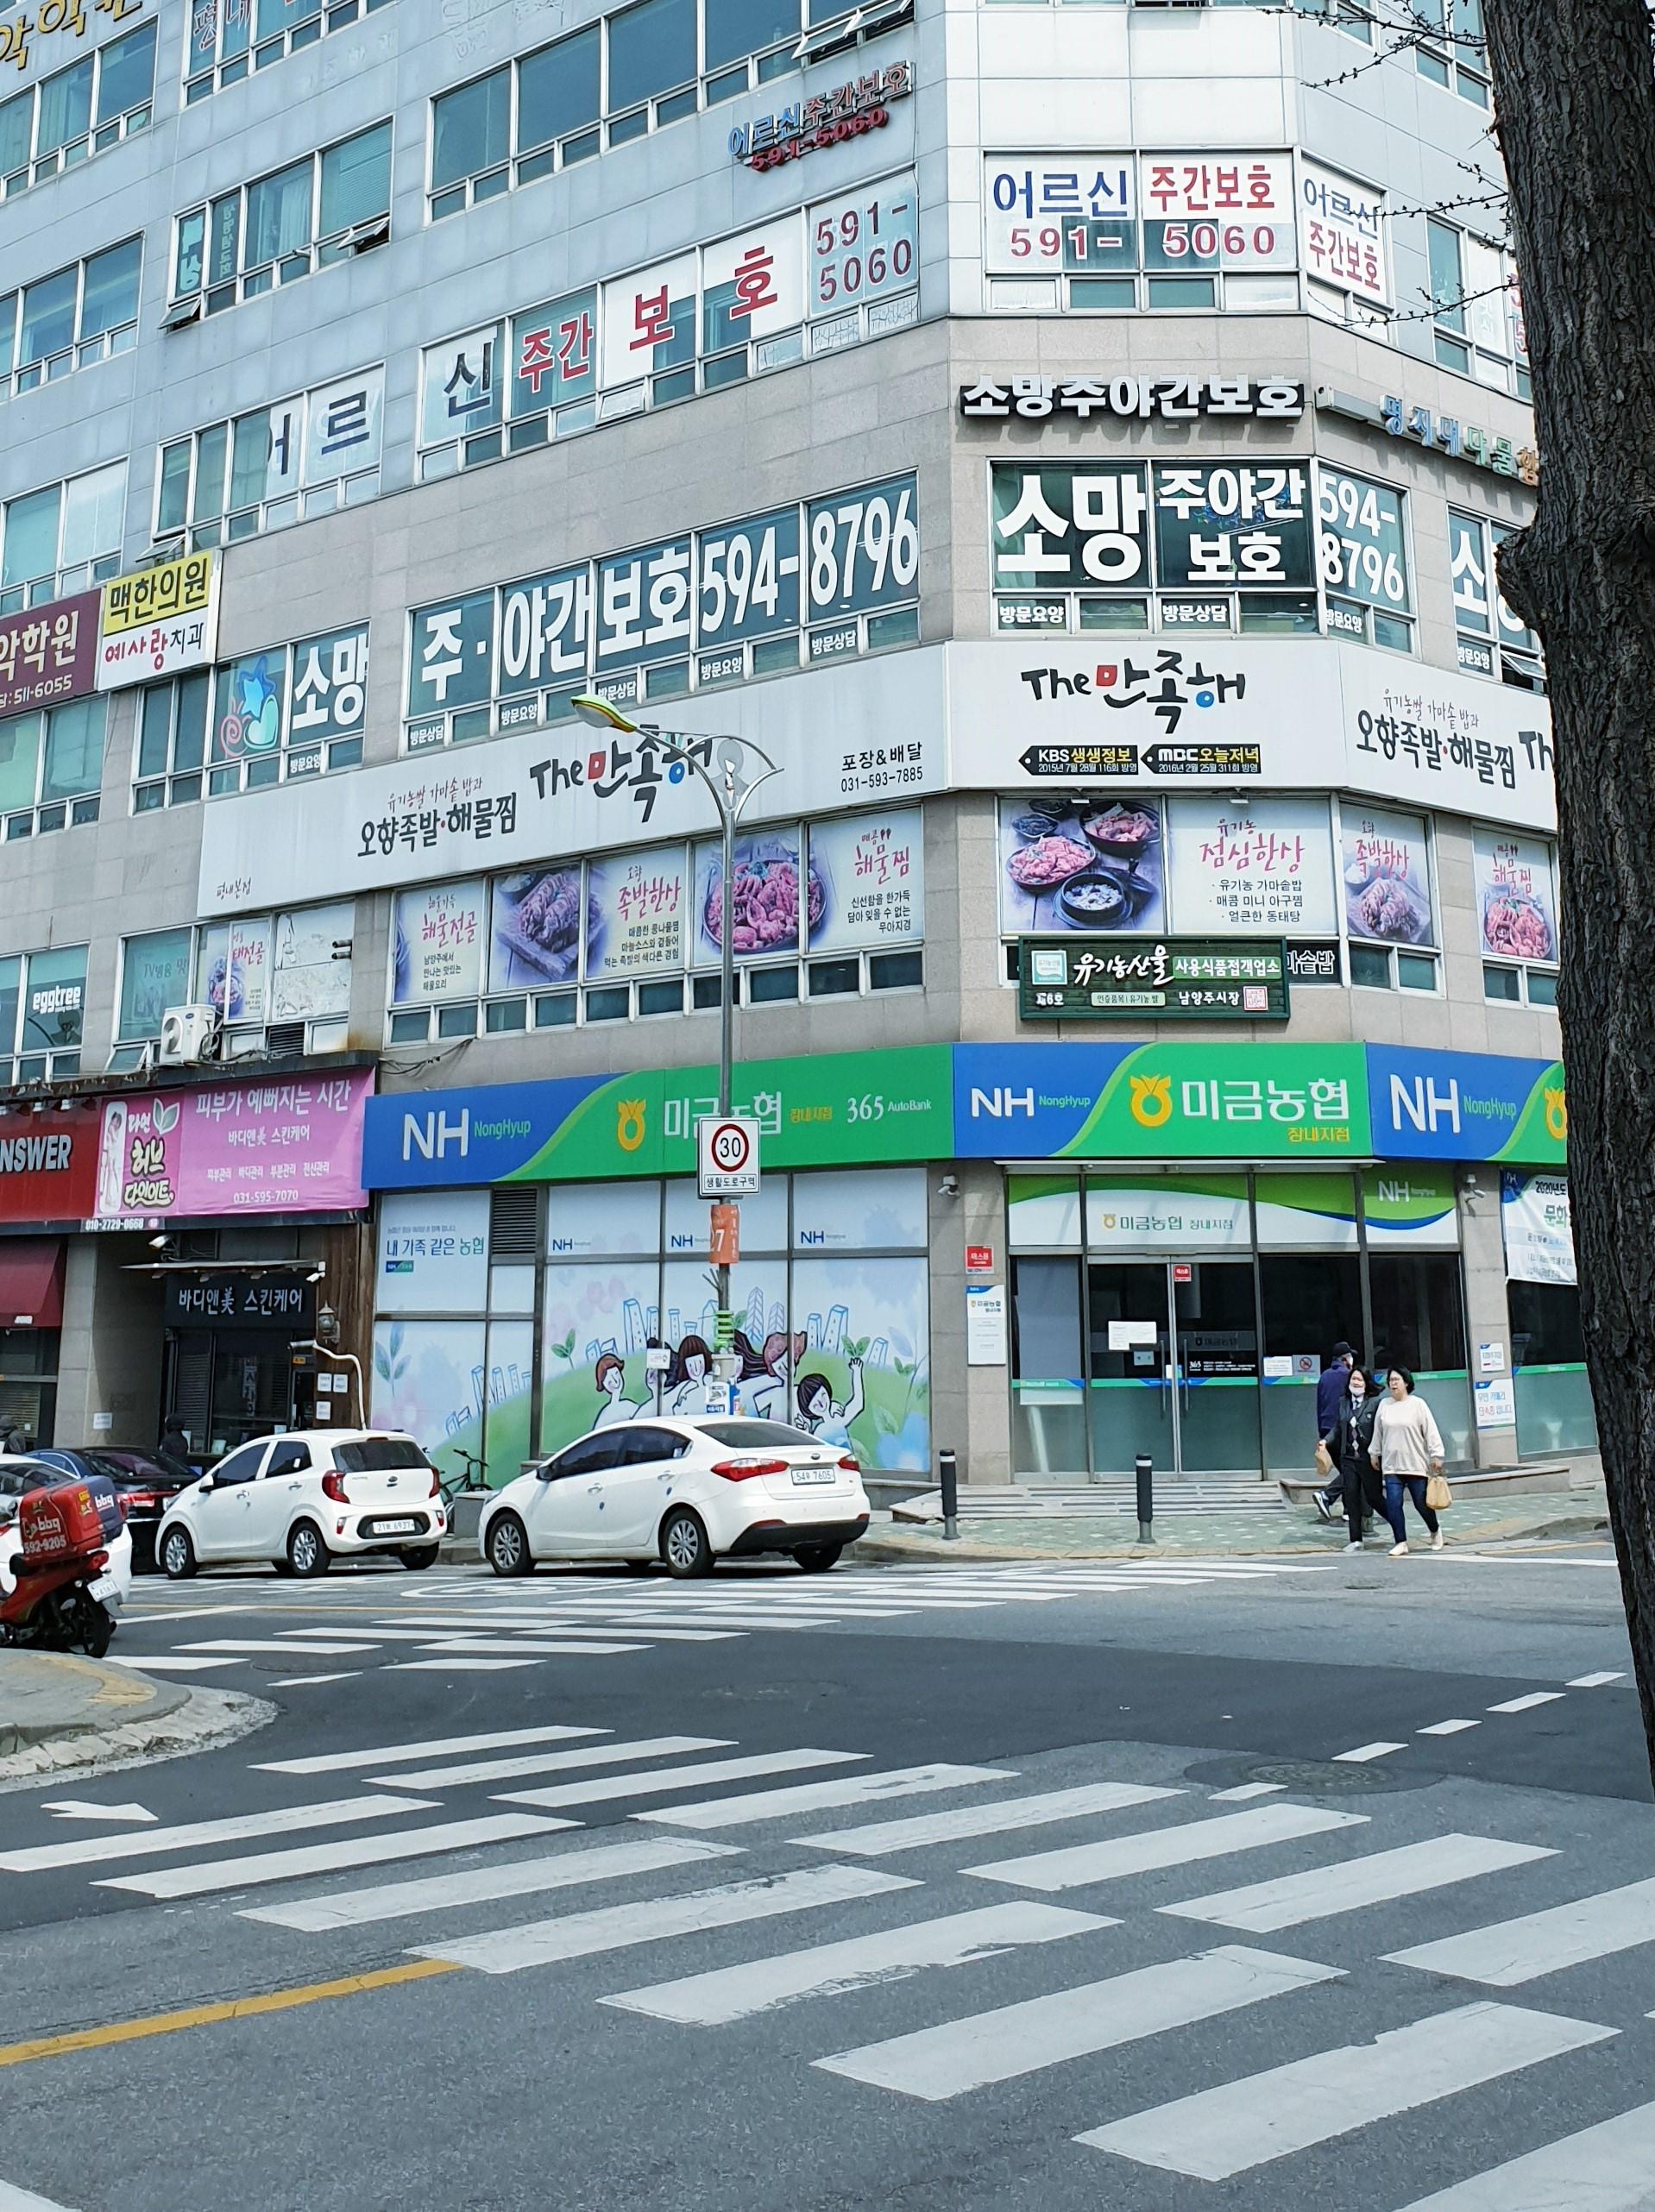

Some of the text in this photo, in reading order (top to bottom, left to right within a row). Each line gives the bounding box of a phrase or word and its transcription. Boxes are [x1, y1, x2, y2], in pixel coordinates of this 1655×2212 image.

[752, 106, 890, 173] 591-5060
[993, 164, 1274, 219] 어르신 주간보호
[1304, 178, 1379, 242] 어르신
[816, 201, 909, 256] 591-
[1010, 223, 1276, 259] 591- 5060
[1309, 220, 1381, 292] 주간보호
[820, 238, 912, 304] 5060
[962, 374, 1304, 419] 소망주야간보호
[1318, 471, 1396, 537] 594-
[997, 468, 1306, 581] 소망 주야간
[1187, 531, 1287, 581] 보호
[1320, 531, 1405, 602] 8796
[109, 557, 209, 623] 맥한의원
[998, 605, 1066, 624] 방문요양
[1161, 603, 1228, 624] 방문상담
[1325, 607, 1363, 635] 방문요양
[104, 622, 205, 670] 예사랑치과
[811, 630, 857, 656] 방문상담
[293, 632, 369, 731] 소망
[700, 654, 744, 682] 방문요양
[1021, 649, 1247, 735] The만족해
[500, 702, 539, 726] 방문요양
[409, 724, 446, 747] 방문상담
[289, 753, 322, 775] 방문요양
[840, 741, 924, 772] 포장&배달
[1038, 747, 1133, 764] KBS 생생정보
[1038, 763, 1064, 773] 2015년
[1065, 763, 1079, 773] 7월
[1098, 763, 1120, 773] 116회
[1121, 763, 1138, 773] 방영
[1158, 746, 1260, 764] MBC 오늘저녁
[1158, 763, 1185, 773] 2016년
[1218, 763, 1241, 773] 311회
[840, 767, 924, 794] 031-593-7885
[1217, 818, 1257, 838] 유기농
[853, 844, 909, 885] 해물찜
[1199, 832, 1306, 873] 점심한상
[1218, 879, 1254, 892] 유기농
[1492, 852, 1532, 898] 해물찜
[617, 875, 682, 921] 족발한상
[851, 889, 910, 909] 신선함을 한가득
[1216, 894, 1303, 908] 매콤 미니 아구찜
[884, 907, 892, 920] 수
[894, 905, 911, 919] 없는
[1229, 910, 1301, 923] 얼큰한 동태탕
[421, 909, 479, 949] 해물전골
[1174, 957, 1281, 977] 사용식품접객업소
[32, 984, 82, 1015] eggtree
[1178, 991, 1241, 1006] 남양주시장
[195, 1079, 352, 1123] 피부가 예뻐지는 시간
[846, 1093, 884, 1124] 365
[971, 1086, 1091, 1117] NH NongHyup
[1181, 1078, 1350, 1123] 미금농협
[1389, 1071, 1518, 1134] NH NongHyup
[270, 1124, 311, 1145] 스킨케어
[402, 1108, 532, 1161] NH NongHyup
[1287, 1124, 1351, 1143] 장내지점
[719, 1136, 741, 1159] 30
[705, 1176, 757, 1188] 생활도로구역
[1378, 1179, 1410, 1202] NH
[233, 1189, 299, 1204] 031-595-7070
[1120, 1215, 1183, 1231] 미금농협
[387, 1239, 399, 1257] 내
[430, 1237, 456, 1256] 같은
[459, 1235, 484, 1256] 농협
[552, 1238, 573, 1251] NH
[670, 1234, 694, 1247] NH
[800, 1230, 825, 1244] NH
[179, 1285, 303, 1316] 바디앤美 스킨케어
[94, 1493, 115, 1510] bbq
[36, 1513, 61, 1533] bbq
[22, 1533, 67, 1554] 592-9205
